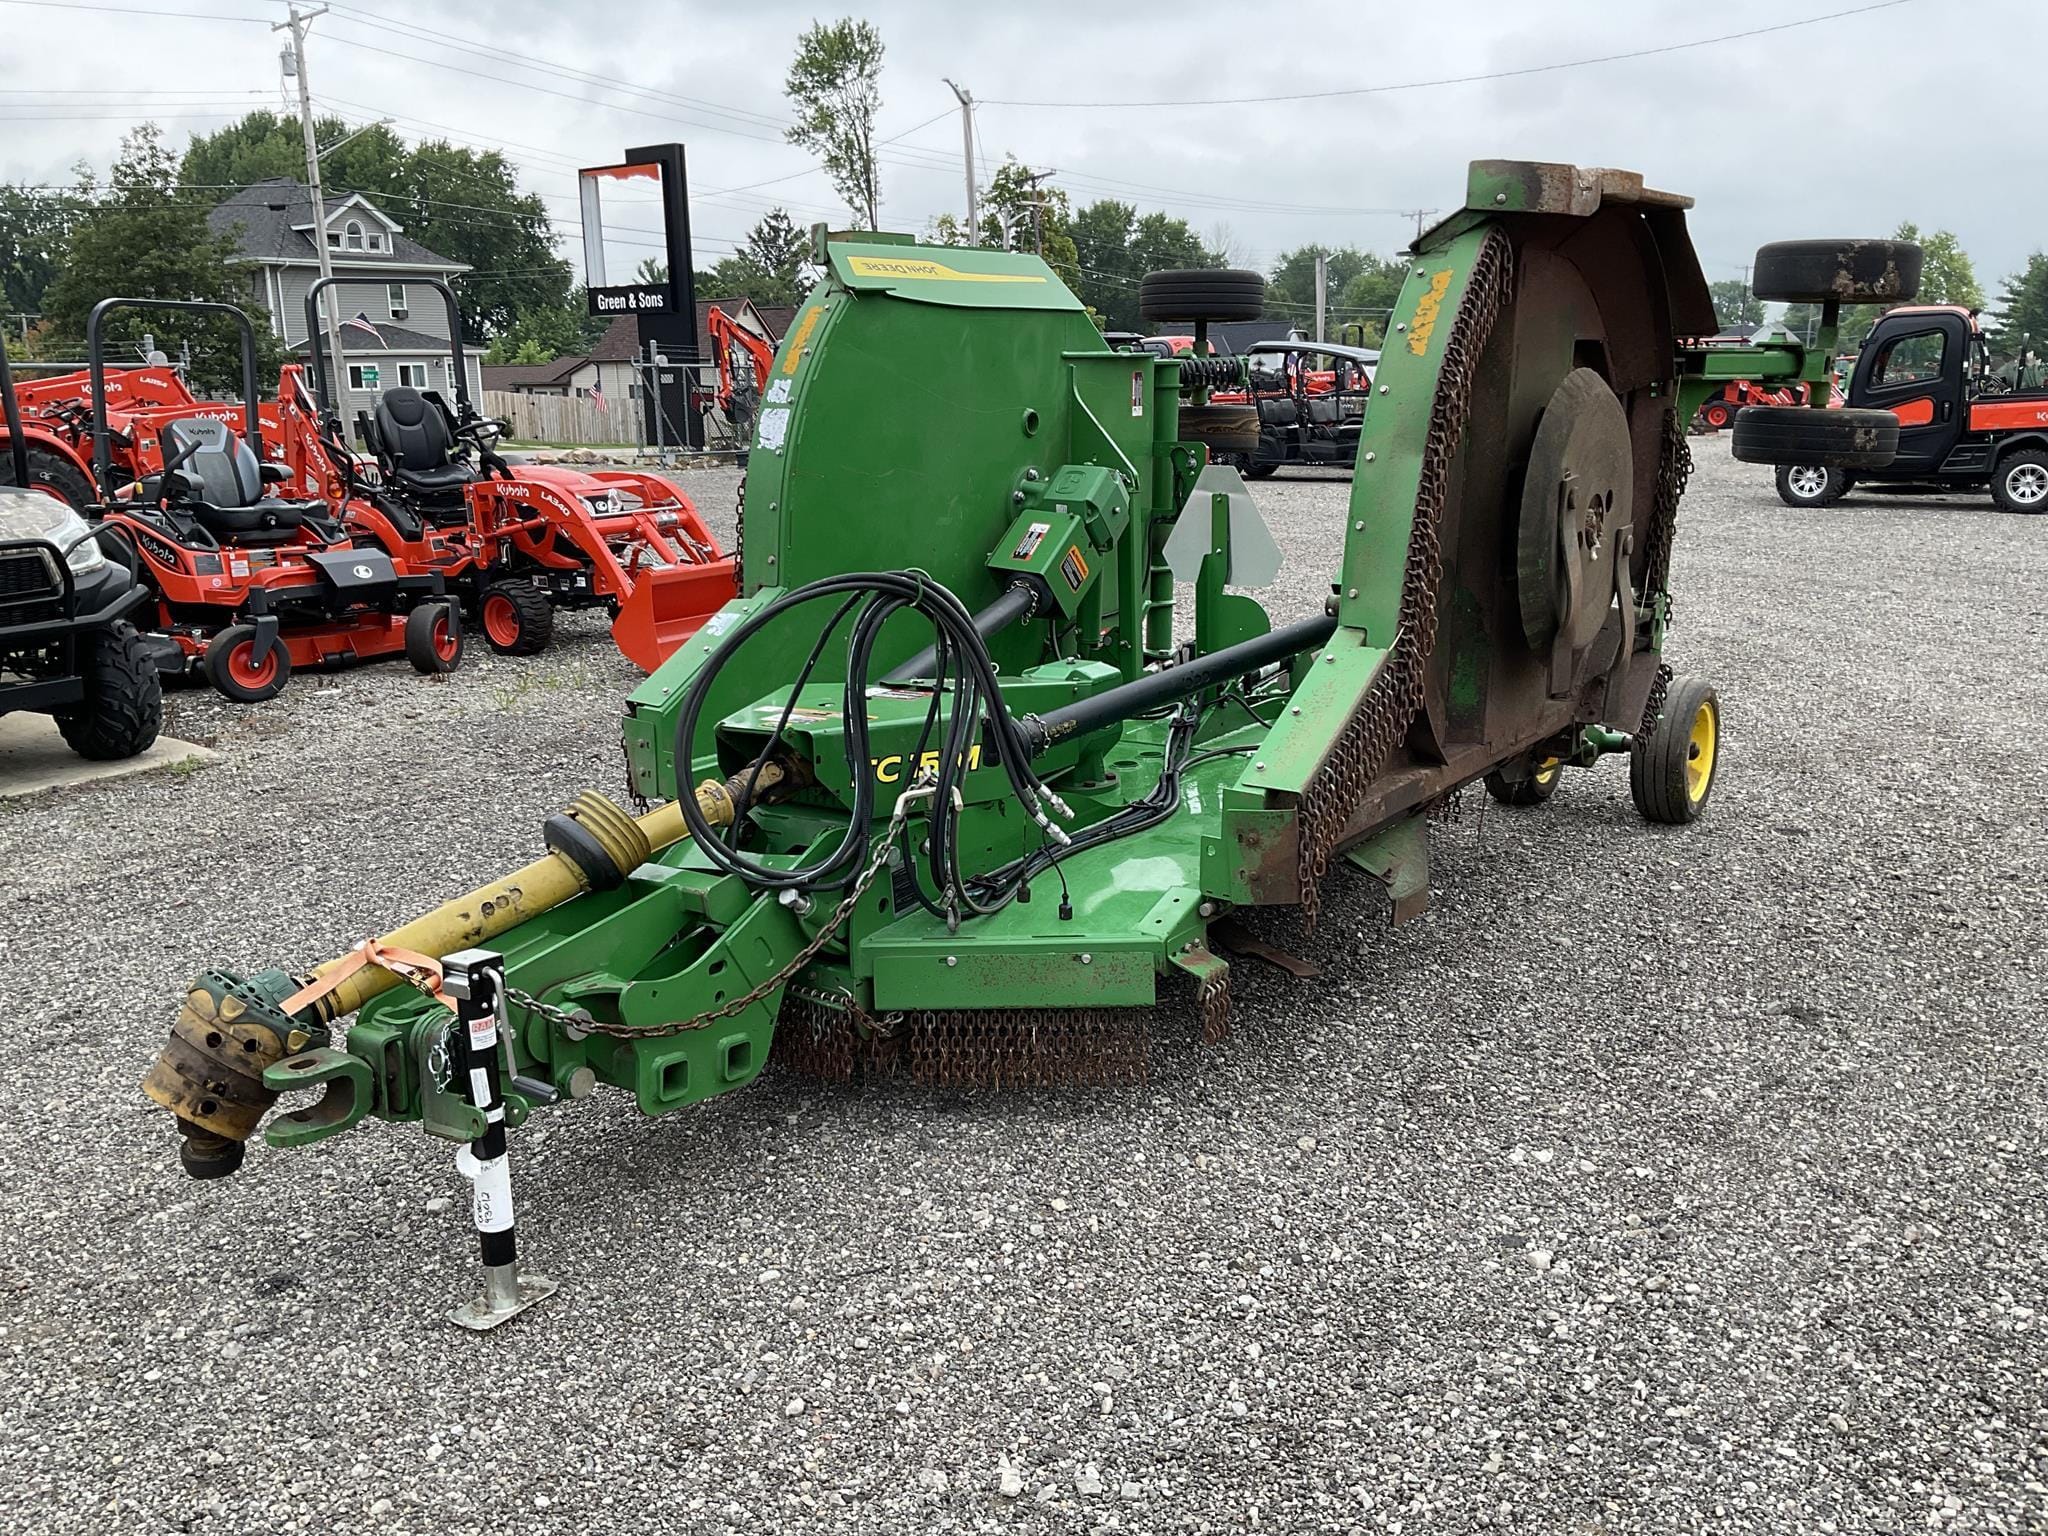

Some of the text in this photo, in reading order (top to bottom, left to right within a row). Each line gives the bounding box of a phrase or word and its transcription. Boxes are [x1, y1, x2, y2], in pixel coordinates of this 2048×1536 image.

[861, 261, 938, 276] JOHN DEERE
[597, 291, 664, 310] Green & Sons
[81, 382, 122, 395] Kuota
[195, 410, 239, 422] Kubota
[305, 432, 327, 472] Kubota
[496, 483, 530, 497] Kubota
[540, 491, 571, 517] LA340
[142, 534, 176, 564] Kubota
